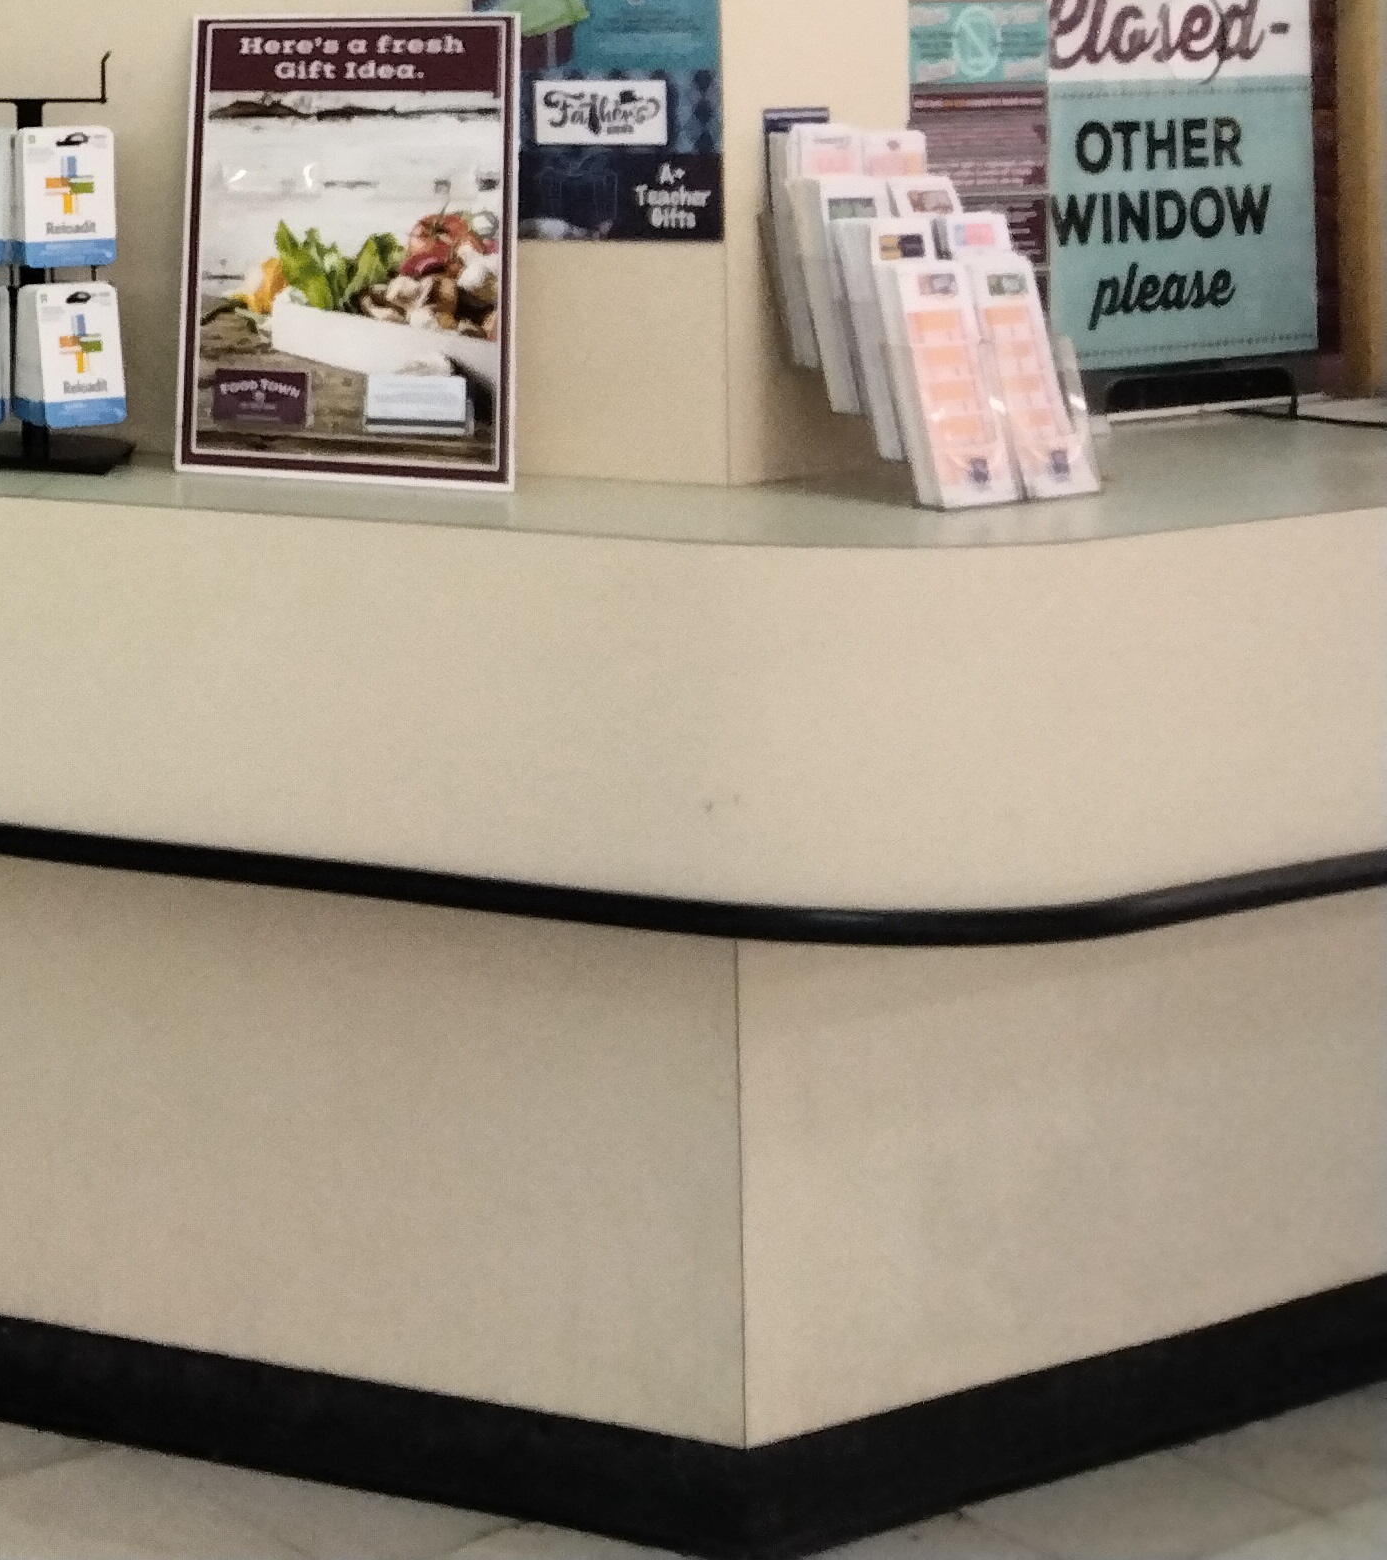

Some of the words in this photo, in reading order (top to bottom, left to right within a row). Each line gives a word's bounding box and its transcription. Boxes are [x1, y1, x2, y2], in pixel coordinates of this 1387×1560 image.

[239, 37, 339, 56] Here's
[347, 39, 367, 55] a
[377, 34, 465, 56] fresh
[275, 61, 336, 80] Gift
[345, 62, 425, 80] Idea.
[1075, 116, 1243, 174] OTHER
[635, 184, 712, 207] Teacher
[651, 207, 696, 229] Gifts
[1050, 183, 1272, 247] WINDOW
[1088, 261, 1236, 331] please
